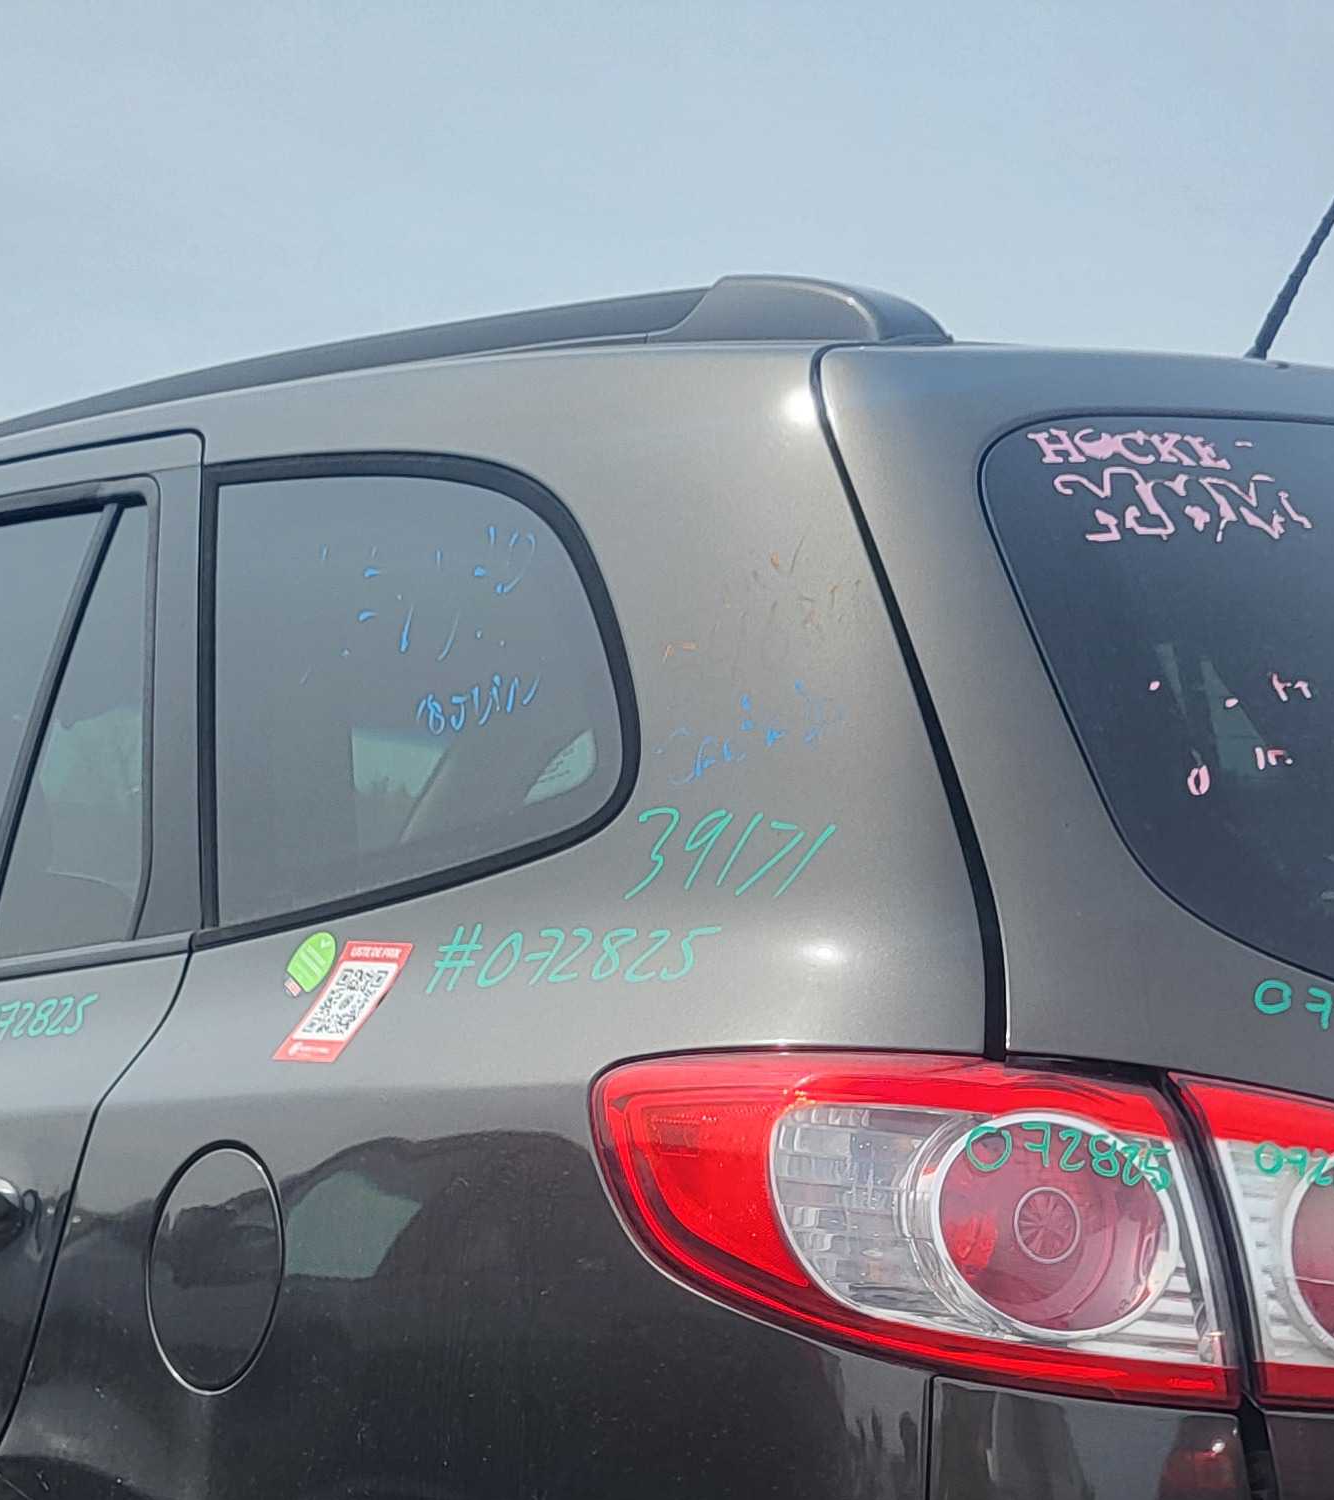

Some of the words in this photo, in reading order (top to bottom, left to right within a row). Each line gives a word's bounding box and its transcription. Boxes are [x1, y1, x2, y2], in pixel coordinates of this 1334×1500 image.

[624, 806, 837, 900] 39171
[426, 923, 721, 993] #072825
[966, 1121, 1172, 1192] 072825
